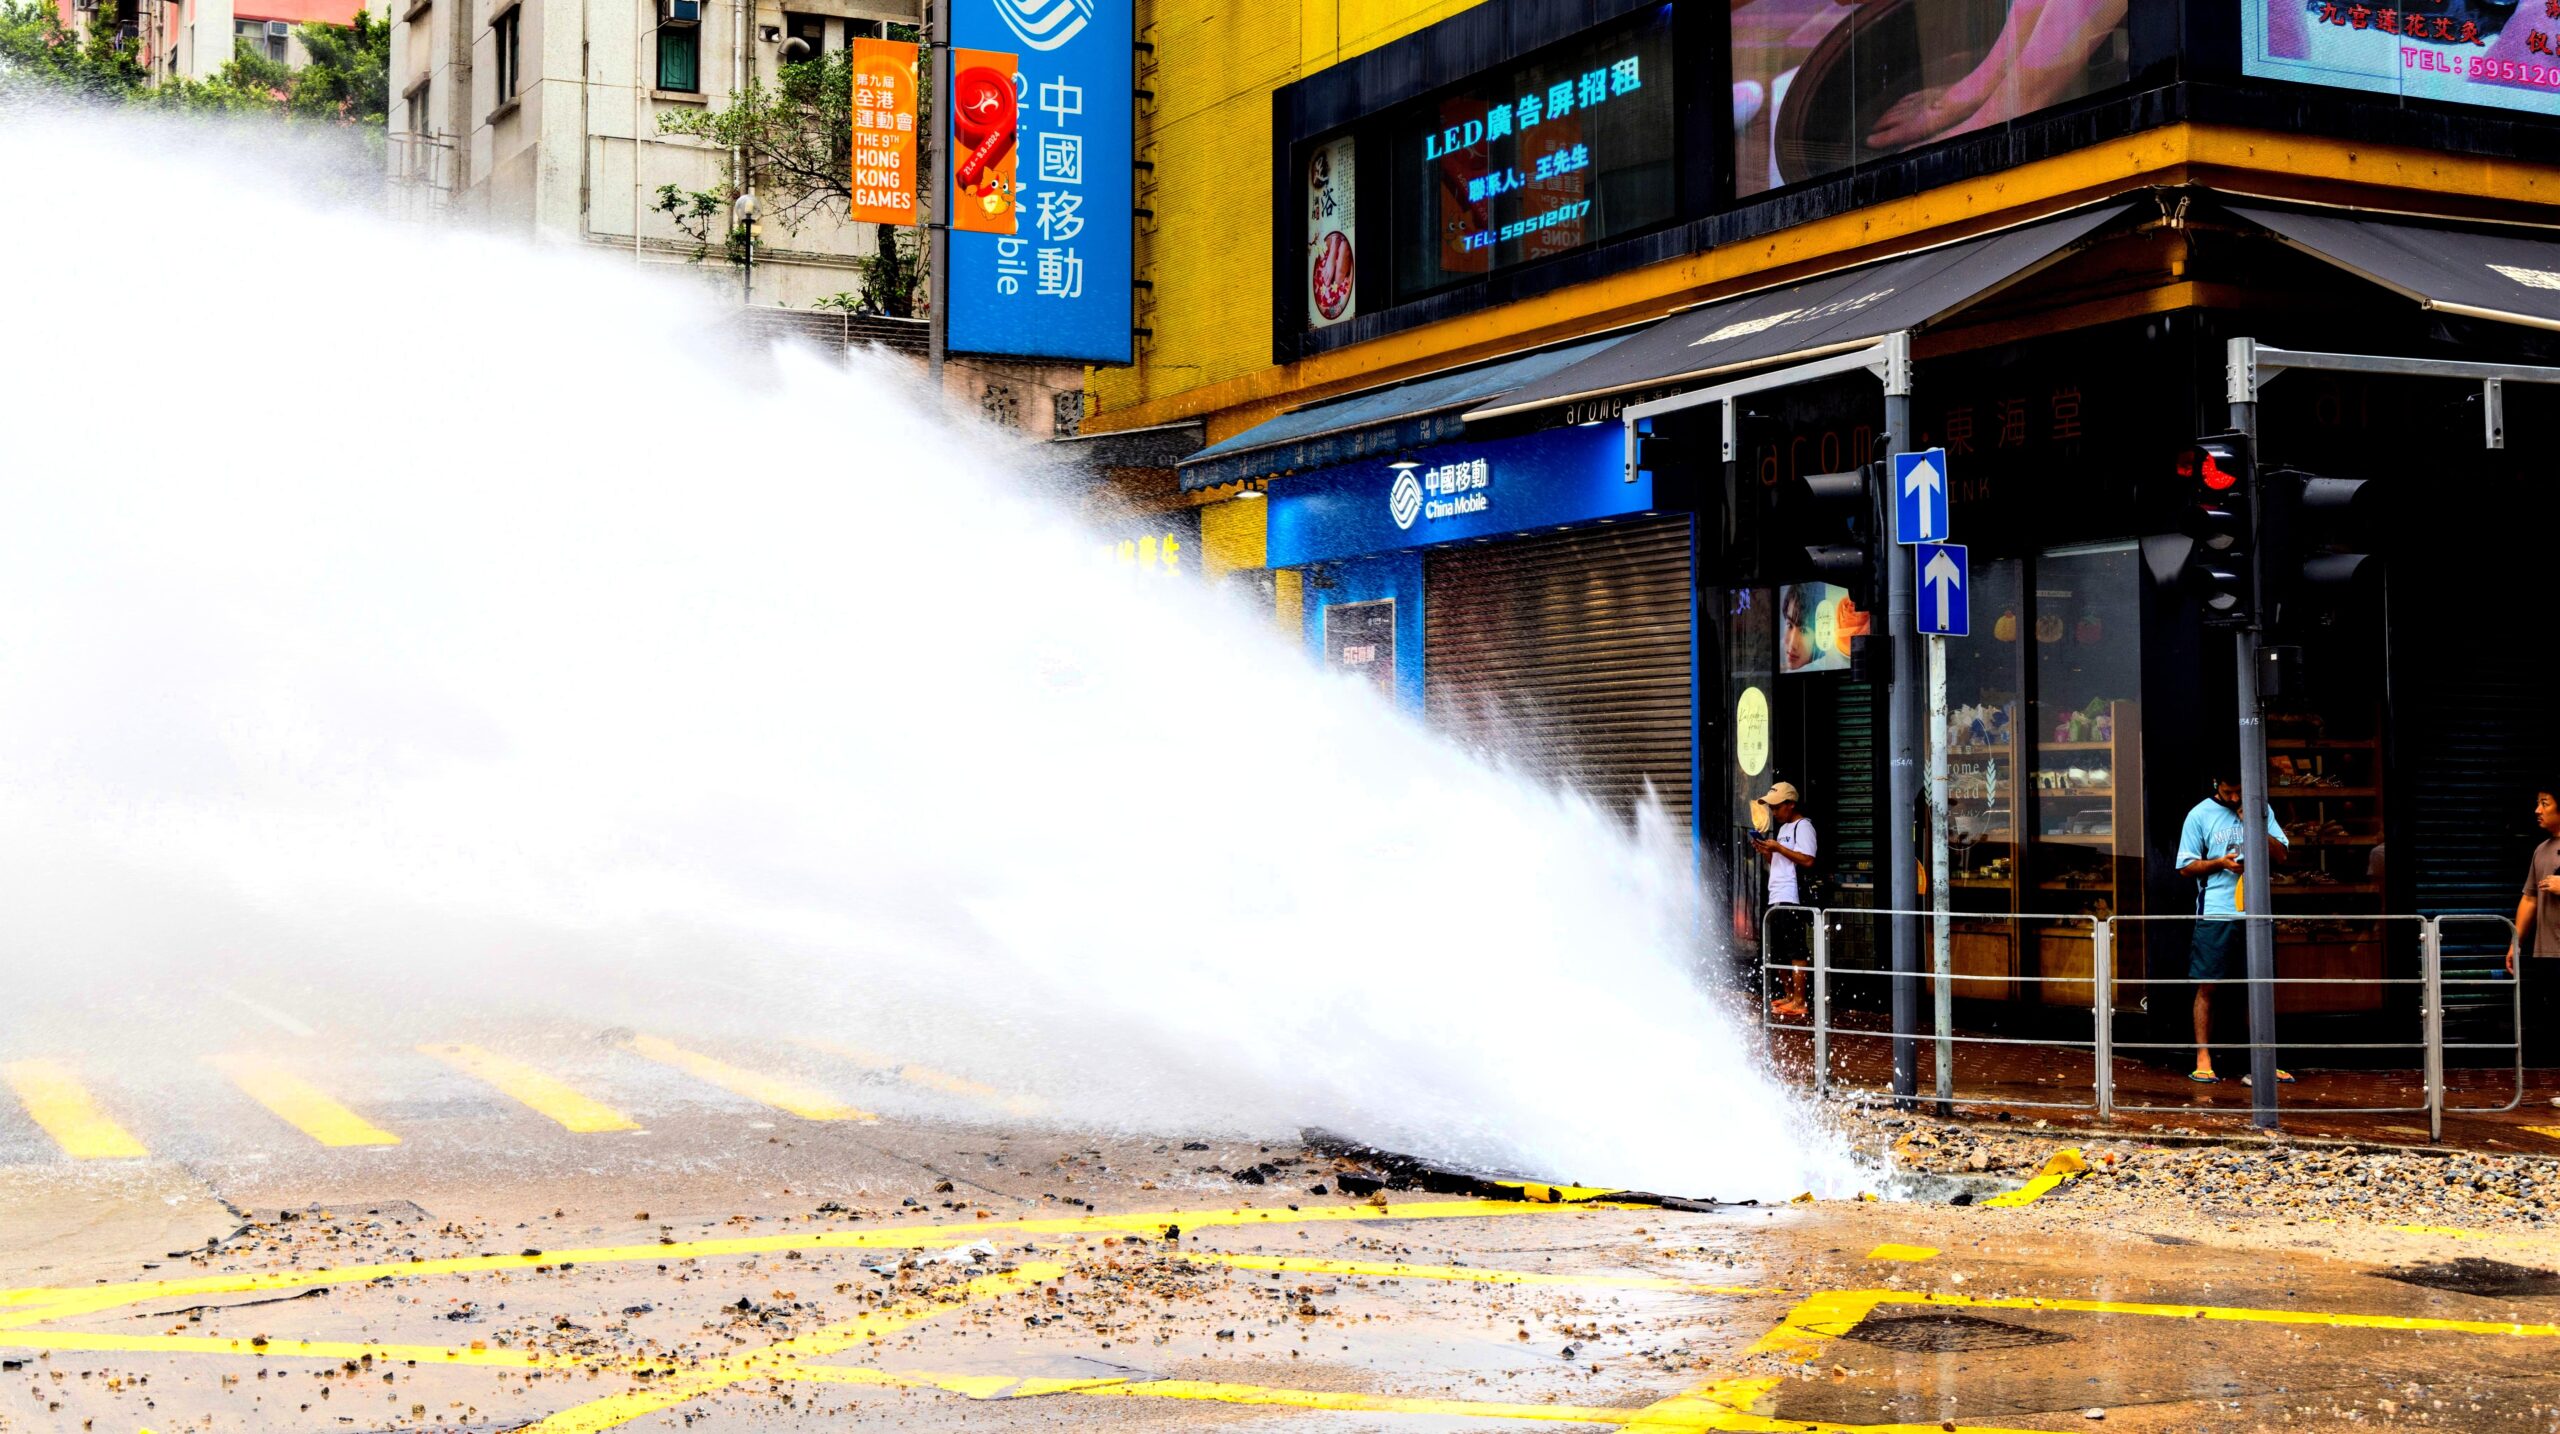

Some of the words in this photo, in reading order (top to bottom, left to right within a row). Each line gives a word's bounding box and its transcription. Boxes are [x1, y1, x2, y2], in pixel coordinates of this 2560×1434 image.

[2526, 29, 2560, 56] 仪
[857, 88, 895, 109] 全港
[856, 109, 913, 131] 運動會
[856, 132, 880, 147] THE
[882, 134, 900, 148] 9TH
[856, 148, 900, 168] HONG
[1535, 143, 1589, 181] 王先生
[856, 169, 900, 188] KONG
[1036, 75, 1085, 299] 中國移動
[856, 188, 911, 209] GAMES
[1500, 200, 1591, 241] 59512017
[1567, 398, 1621, 424] arome
[1946, 385, 2082, 456] 東海堂
[1761, 426, 1873, 487] arom
[1425, 458, 1488, 496] 中國移動
[1949, 477, 1990, 504] INK
[1425, 500, 1454, 519] China
[1454, 491, 1488, 514] Mobile
[1947, 763, 1980, 775] rome
[1948, 784, 1979, 799] read
